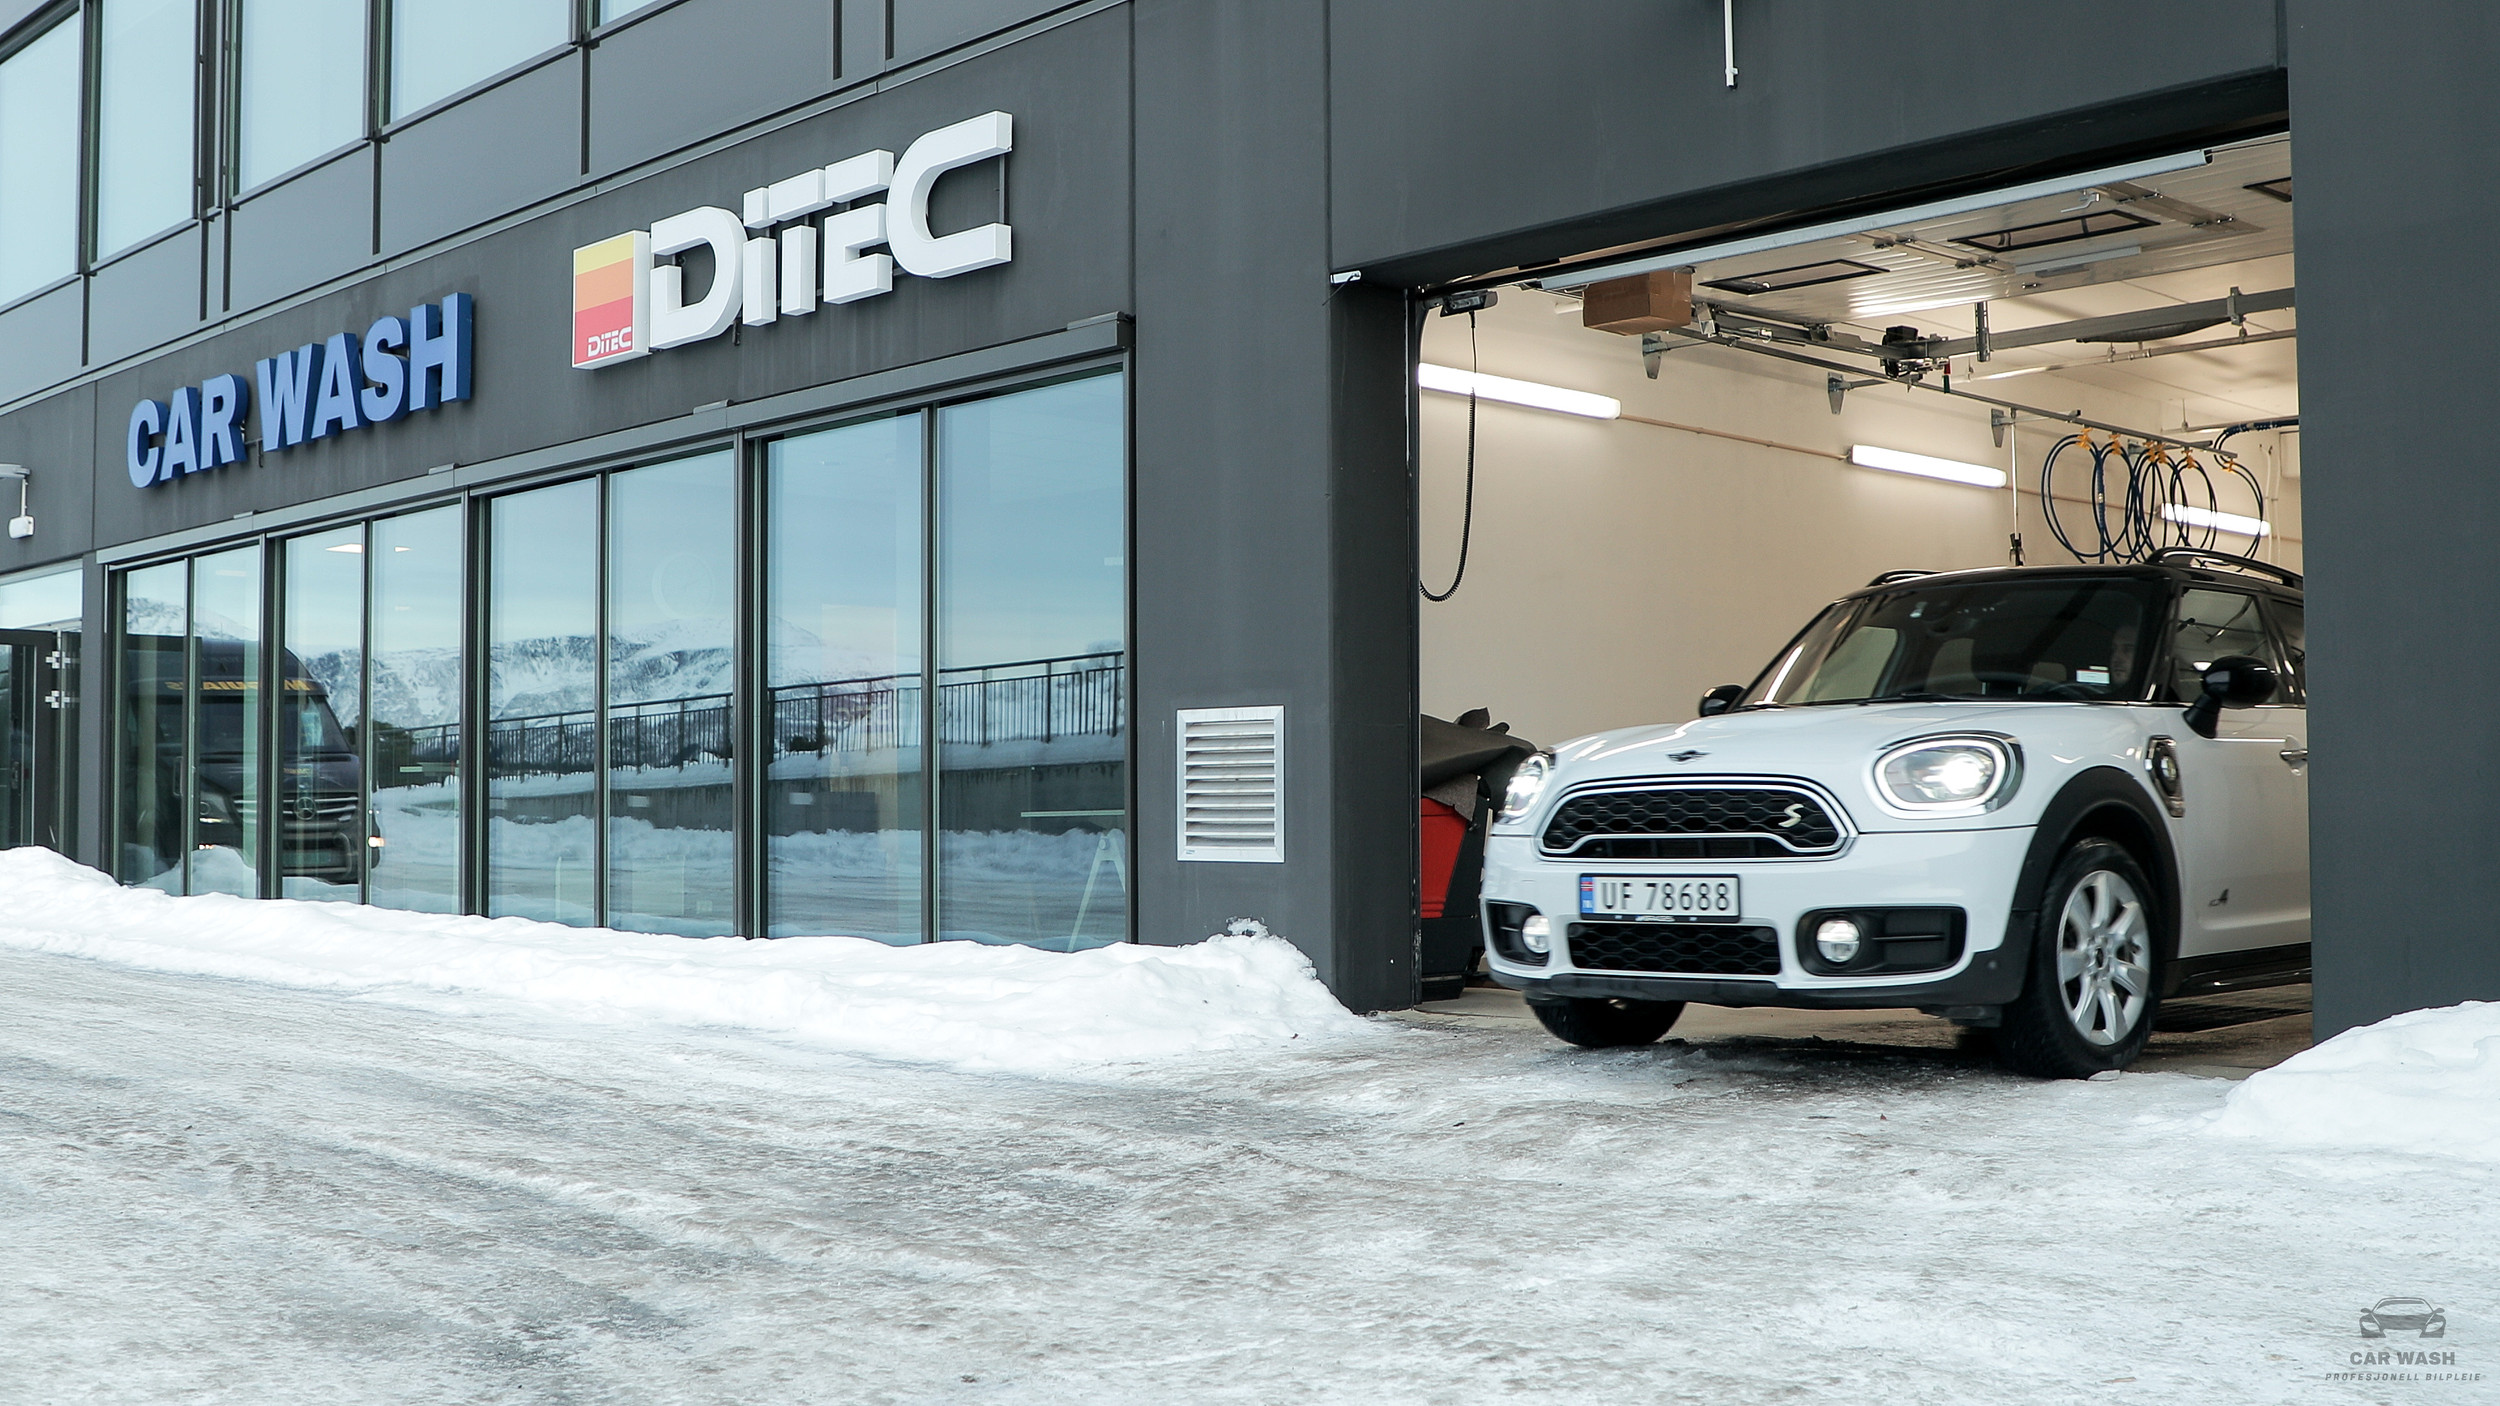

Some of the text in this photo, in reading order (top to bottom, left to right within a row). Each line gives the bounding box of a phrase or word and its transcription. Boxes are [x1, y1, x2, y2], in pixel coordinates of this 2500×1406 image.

[127, 292, 472, 488] CAR WASH
[1601, 882, 1730, 911] UF 78688
